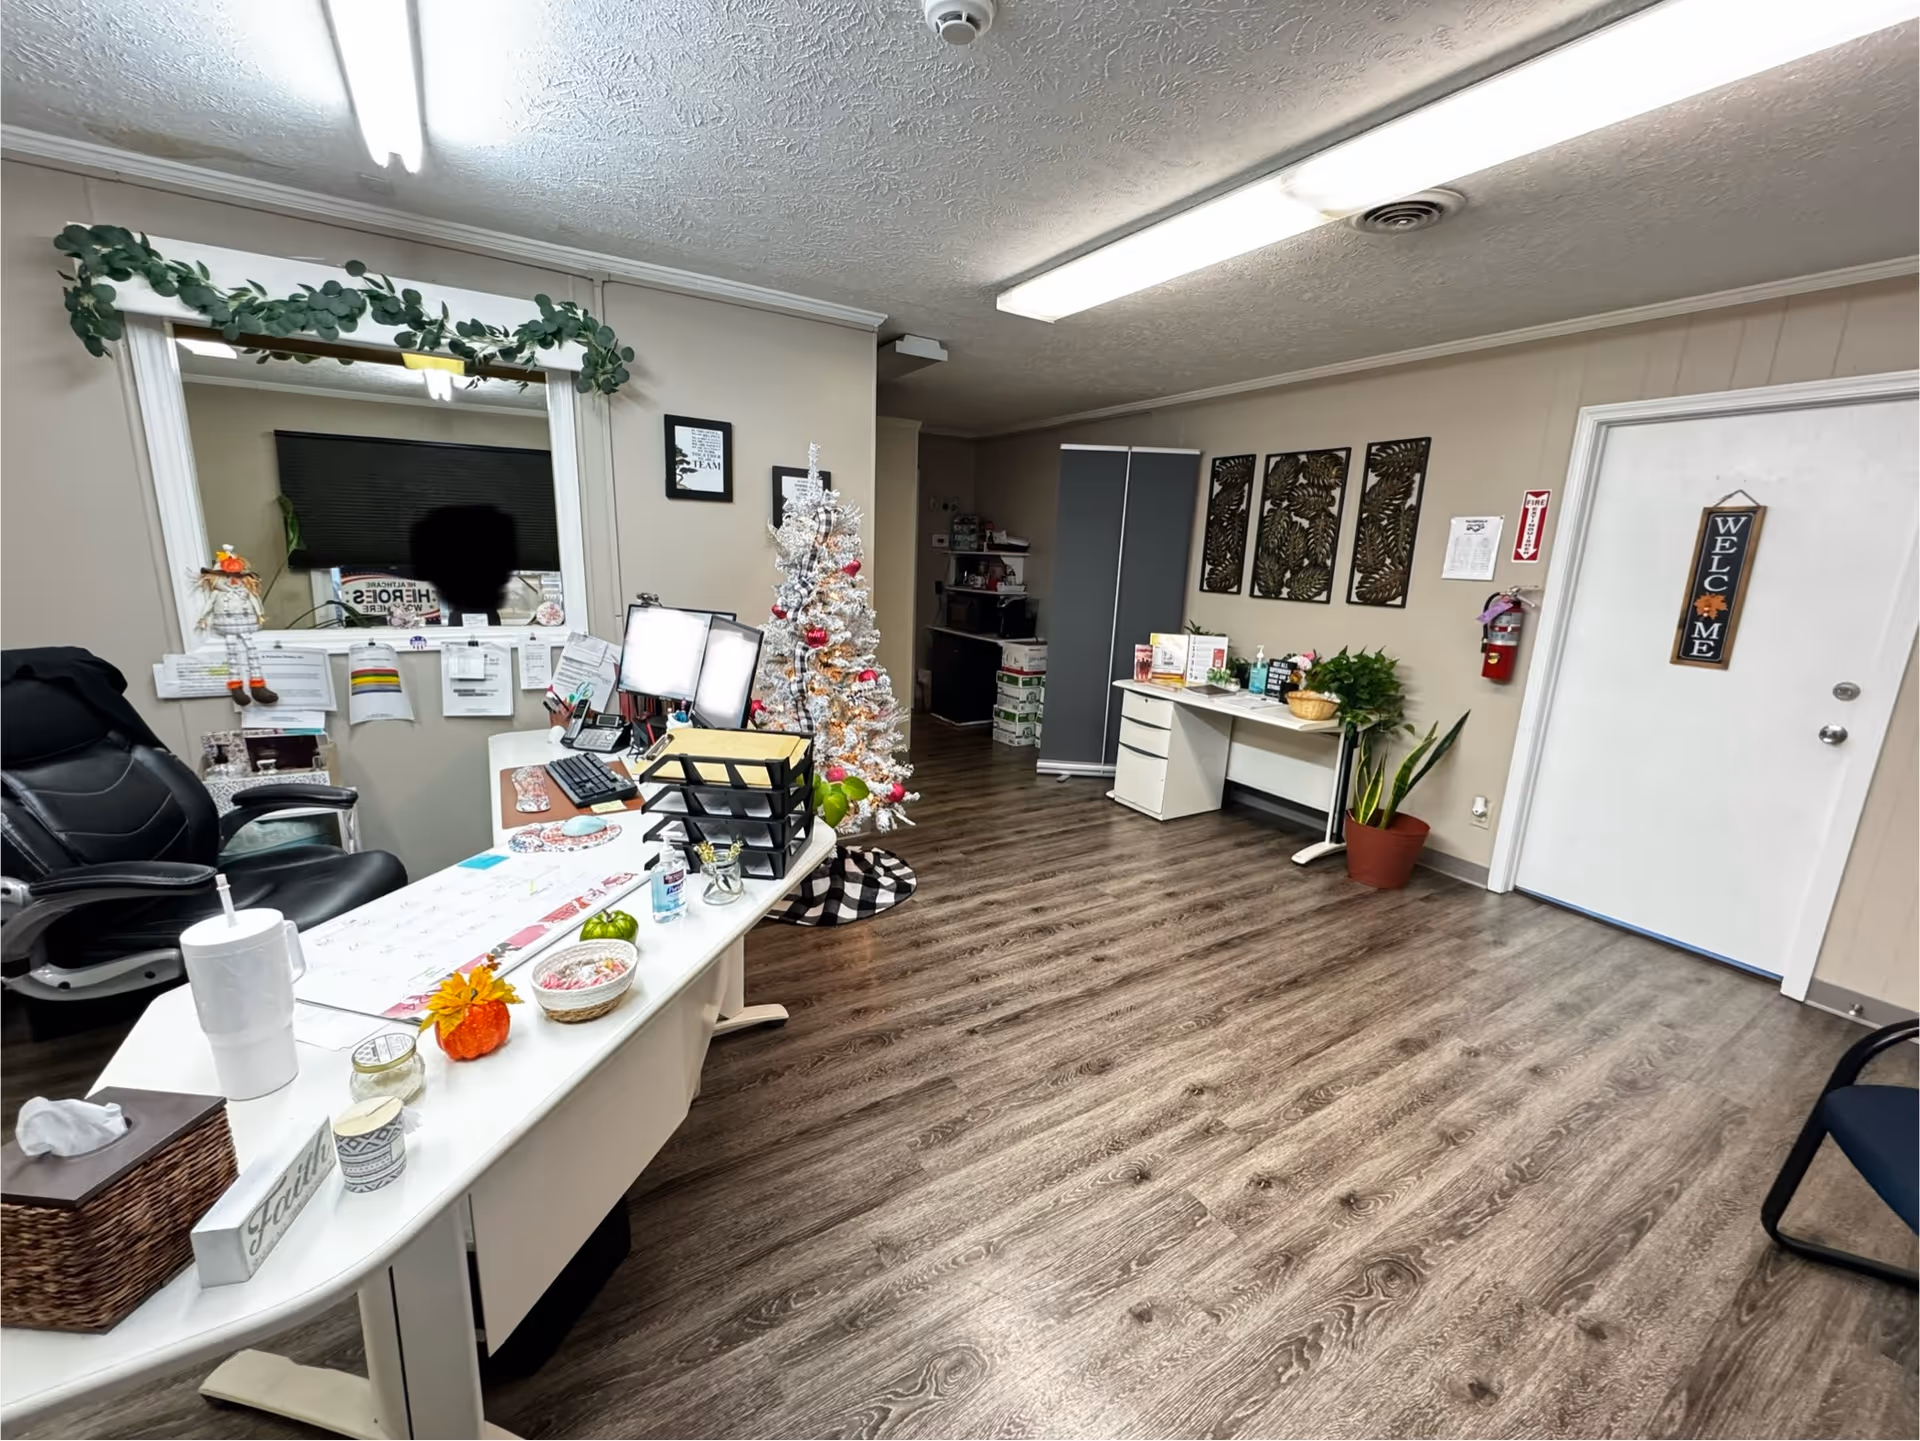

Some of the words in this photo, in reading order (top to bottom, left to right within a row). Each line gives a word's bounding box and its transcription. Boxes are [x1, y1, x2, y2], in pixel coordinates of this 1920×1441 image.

[693, 460, 721, 470] TEAM
[1523, 507, 1538, 555] EXTINGUISHER
[1689, 516, 1748, 657] WELCME
[248, 1130, 331, 1256] Faith
